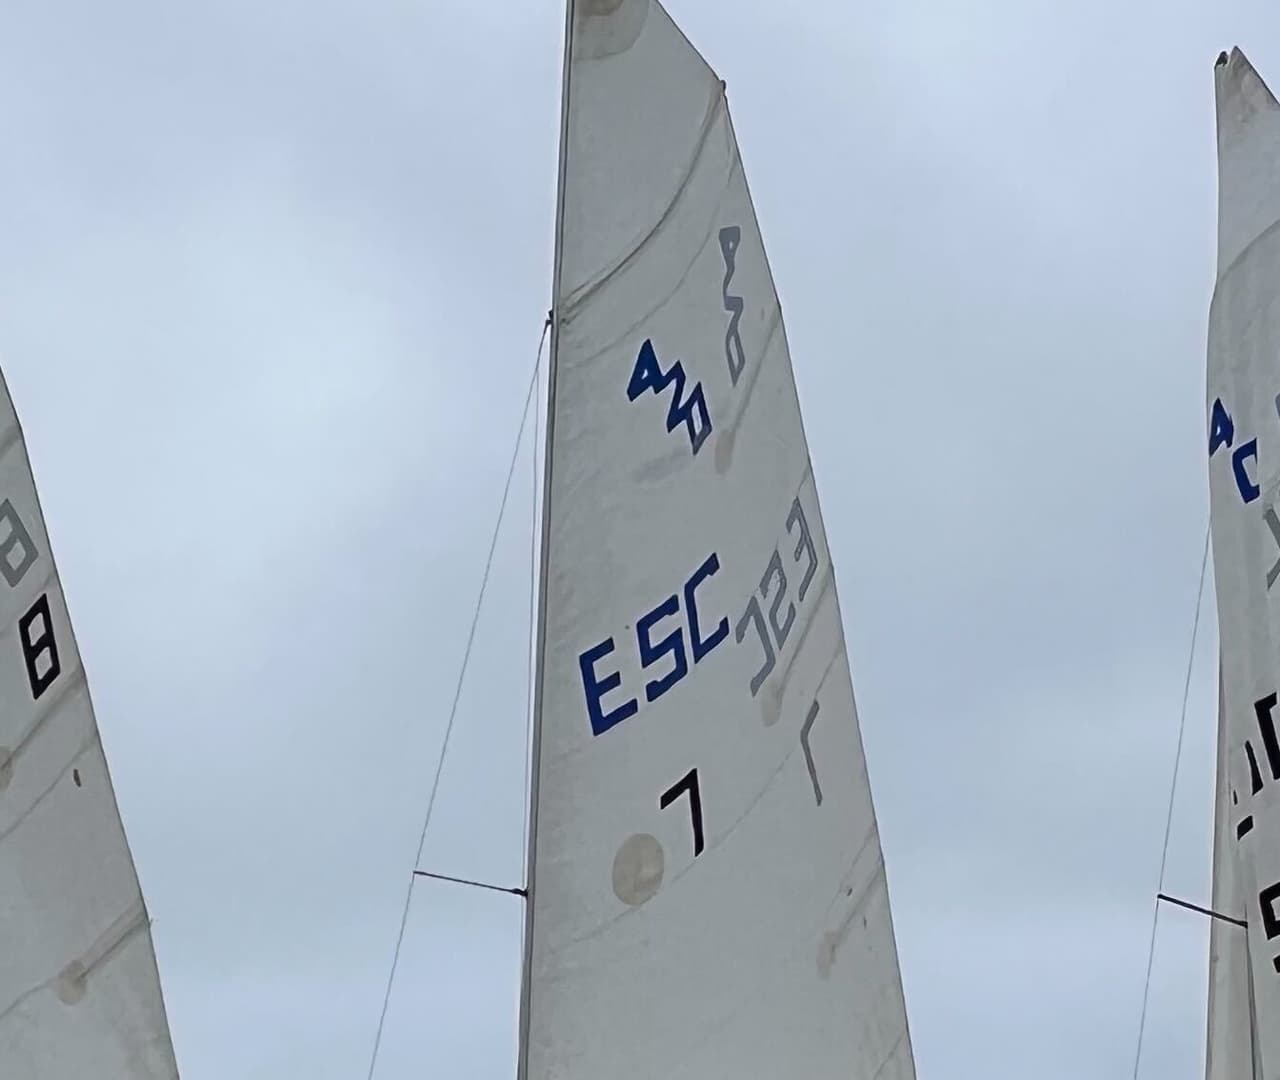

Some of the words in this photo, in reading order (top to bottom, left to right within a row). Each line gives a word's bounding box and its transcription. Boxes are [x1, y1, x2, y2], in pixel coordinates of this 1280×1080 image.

[626, 338, 712, 455] 420
[19, 593, 61, 700] 8
[579, 552, 729, 736] ESC
[660, 768, 704, 857] 7
